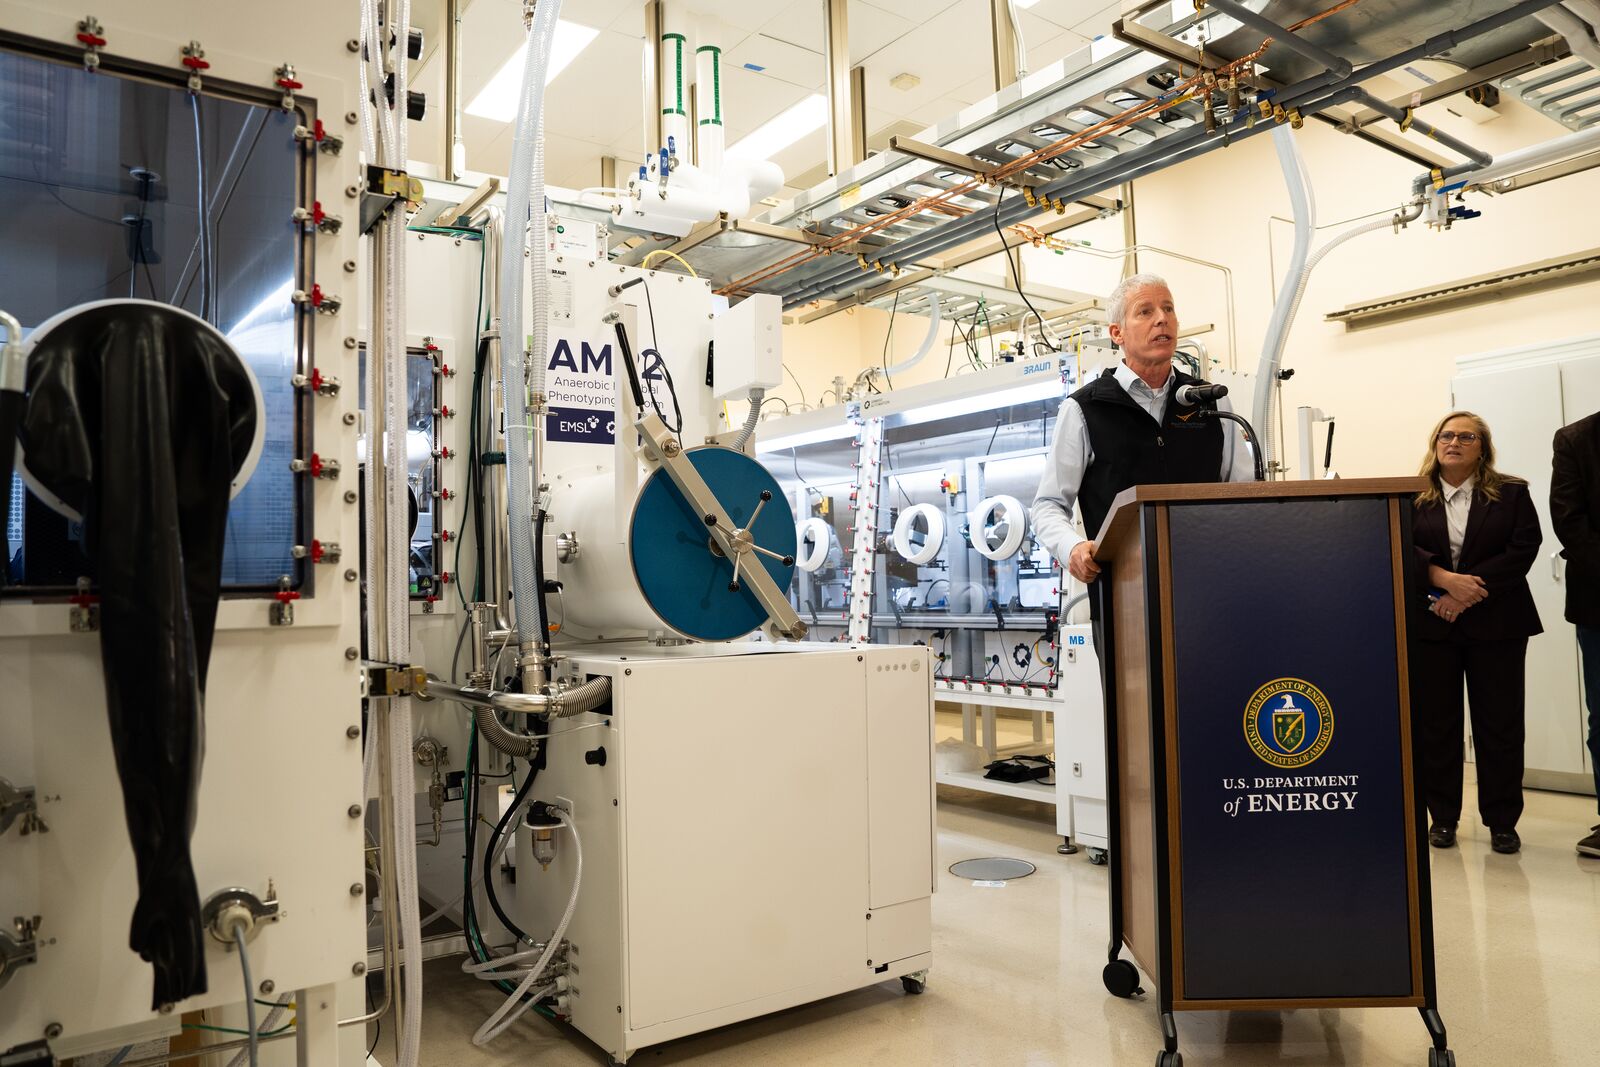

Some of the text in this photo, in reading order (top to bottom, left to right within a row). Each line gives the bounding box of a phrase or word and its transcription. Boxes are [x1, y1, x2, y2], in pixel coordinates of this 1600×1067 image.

[548, 339, 662, 380] AM2
[554, 376, 610, 391] Anaerobic
[560, 421, 592, 434] EMSL
[1069, 635, 1085, 645] MB
[1247, 681, 1330, 720] DEPARTMENT OF ENERGY
[1247, 721, 1331, 765] UNITED STATES OF AMERICA
[1223, 775, 1359, 790] U.S. DEPARTMENT
[1223, 791, 1359, 817] of ENERGY
